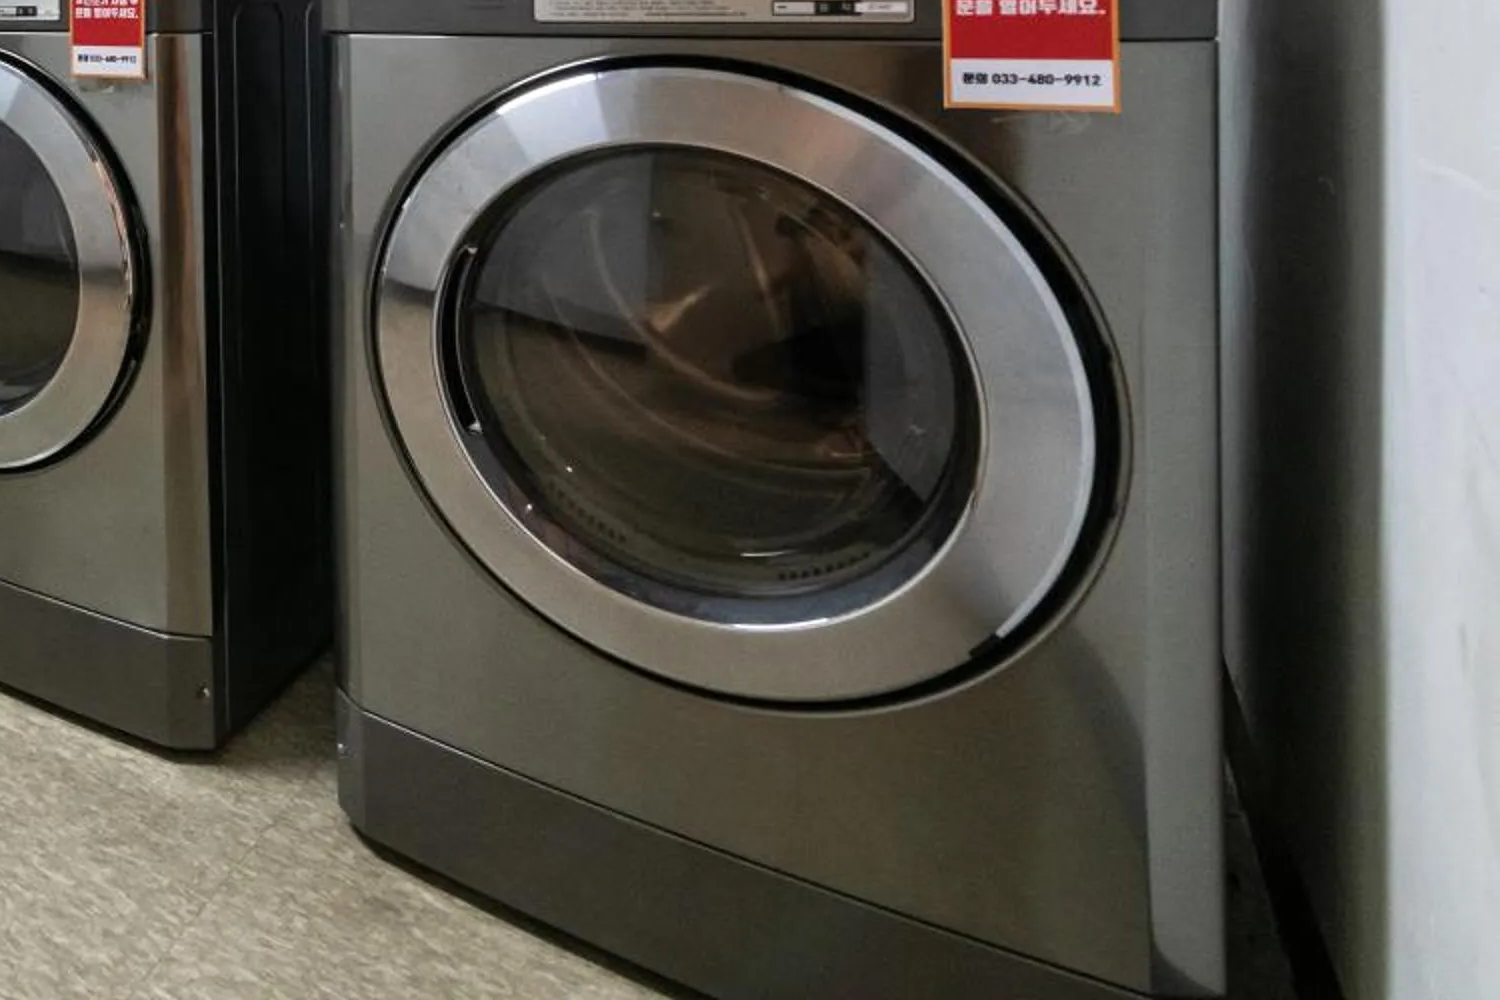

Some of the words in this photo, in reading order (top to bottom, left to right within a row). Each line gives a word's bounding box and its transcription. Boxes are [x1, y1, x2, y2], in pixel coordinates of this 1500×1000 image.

[75, 7, 92, 19] 문을
[961, 72, 990, 86] 문의
[991, 72, 1102, 87] 033-480-9912
